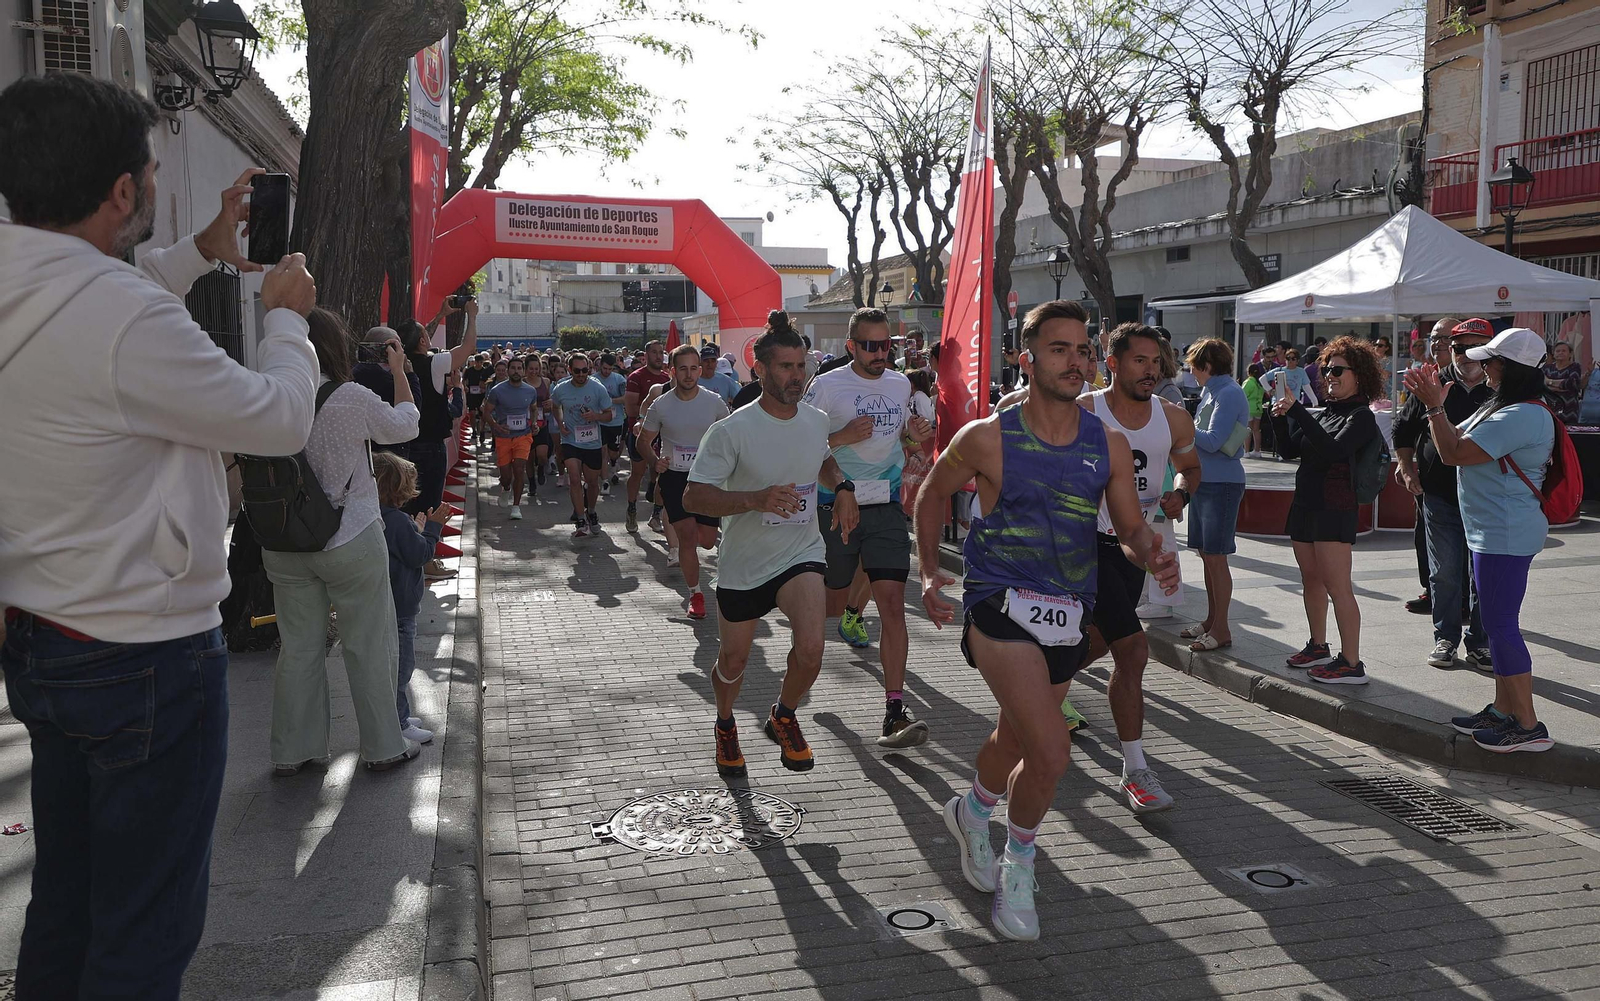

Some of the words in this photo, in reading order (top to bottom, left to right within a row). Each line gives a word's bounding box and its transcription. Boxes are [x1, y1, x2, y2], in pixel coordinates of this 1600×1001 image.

[508, 202, 581, 219] Delegación
[583, 206, 599, 220] de
[602, 207, 658, 223] Deportes
[508, 218, 538, 230] Ilustre
[540, 219, 600, 234] Ayuntamiento
[601, 223, 613, 235] de
[614, 225, 631, 236] San
[631, 226, 659, 237] Roque
[580, 430, 593, 438] 246
[1017, 593, 1043, 602] PUENTE
[1043, 596, 1071, 606] MAYORGA
[1029, 605, 1067, 628] 240
